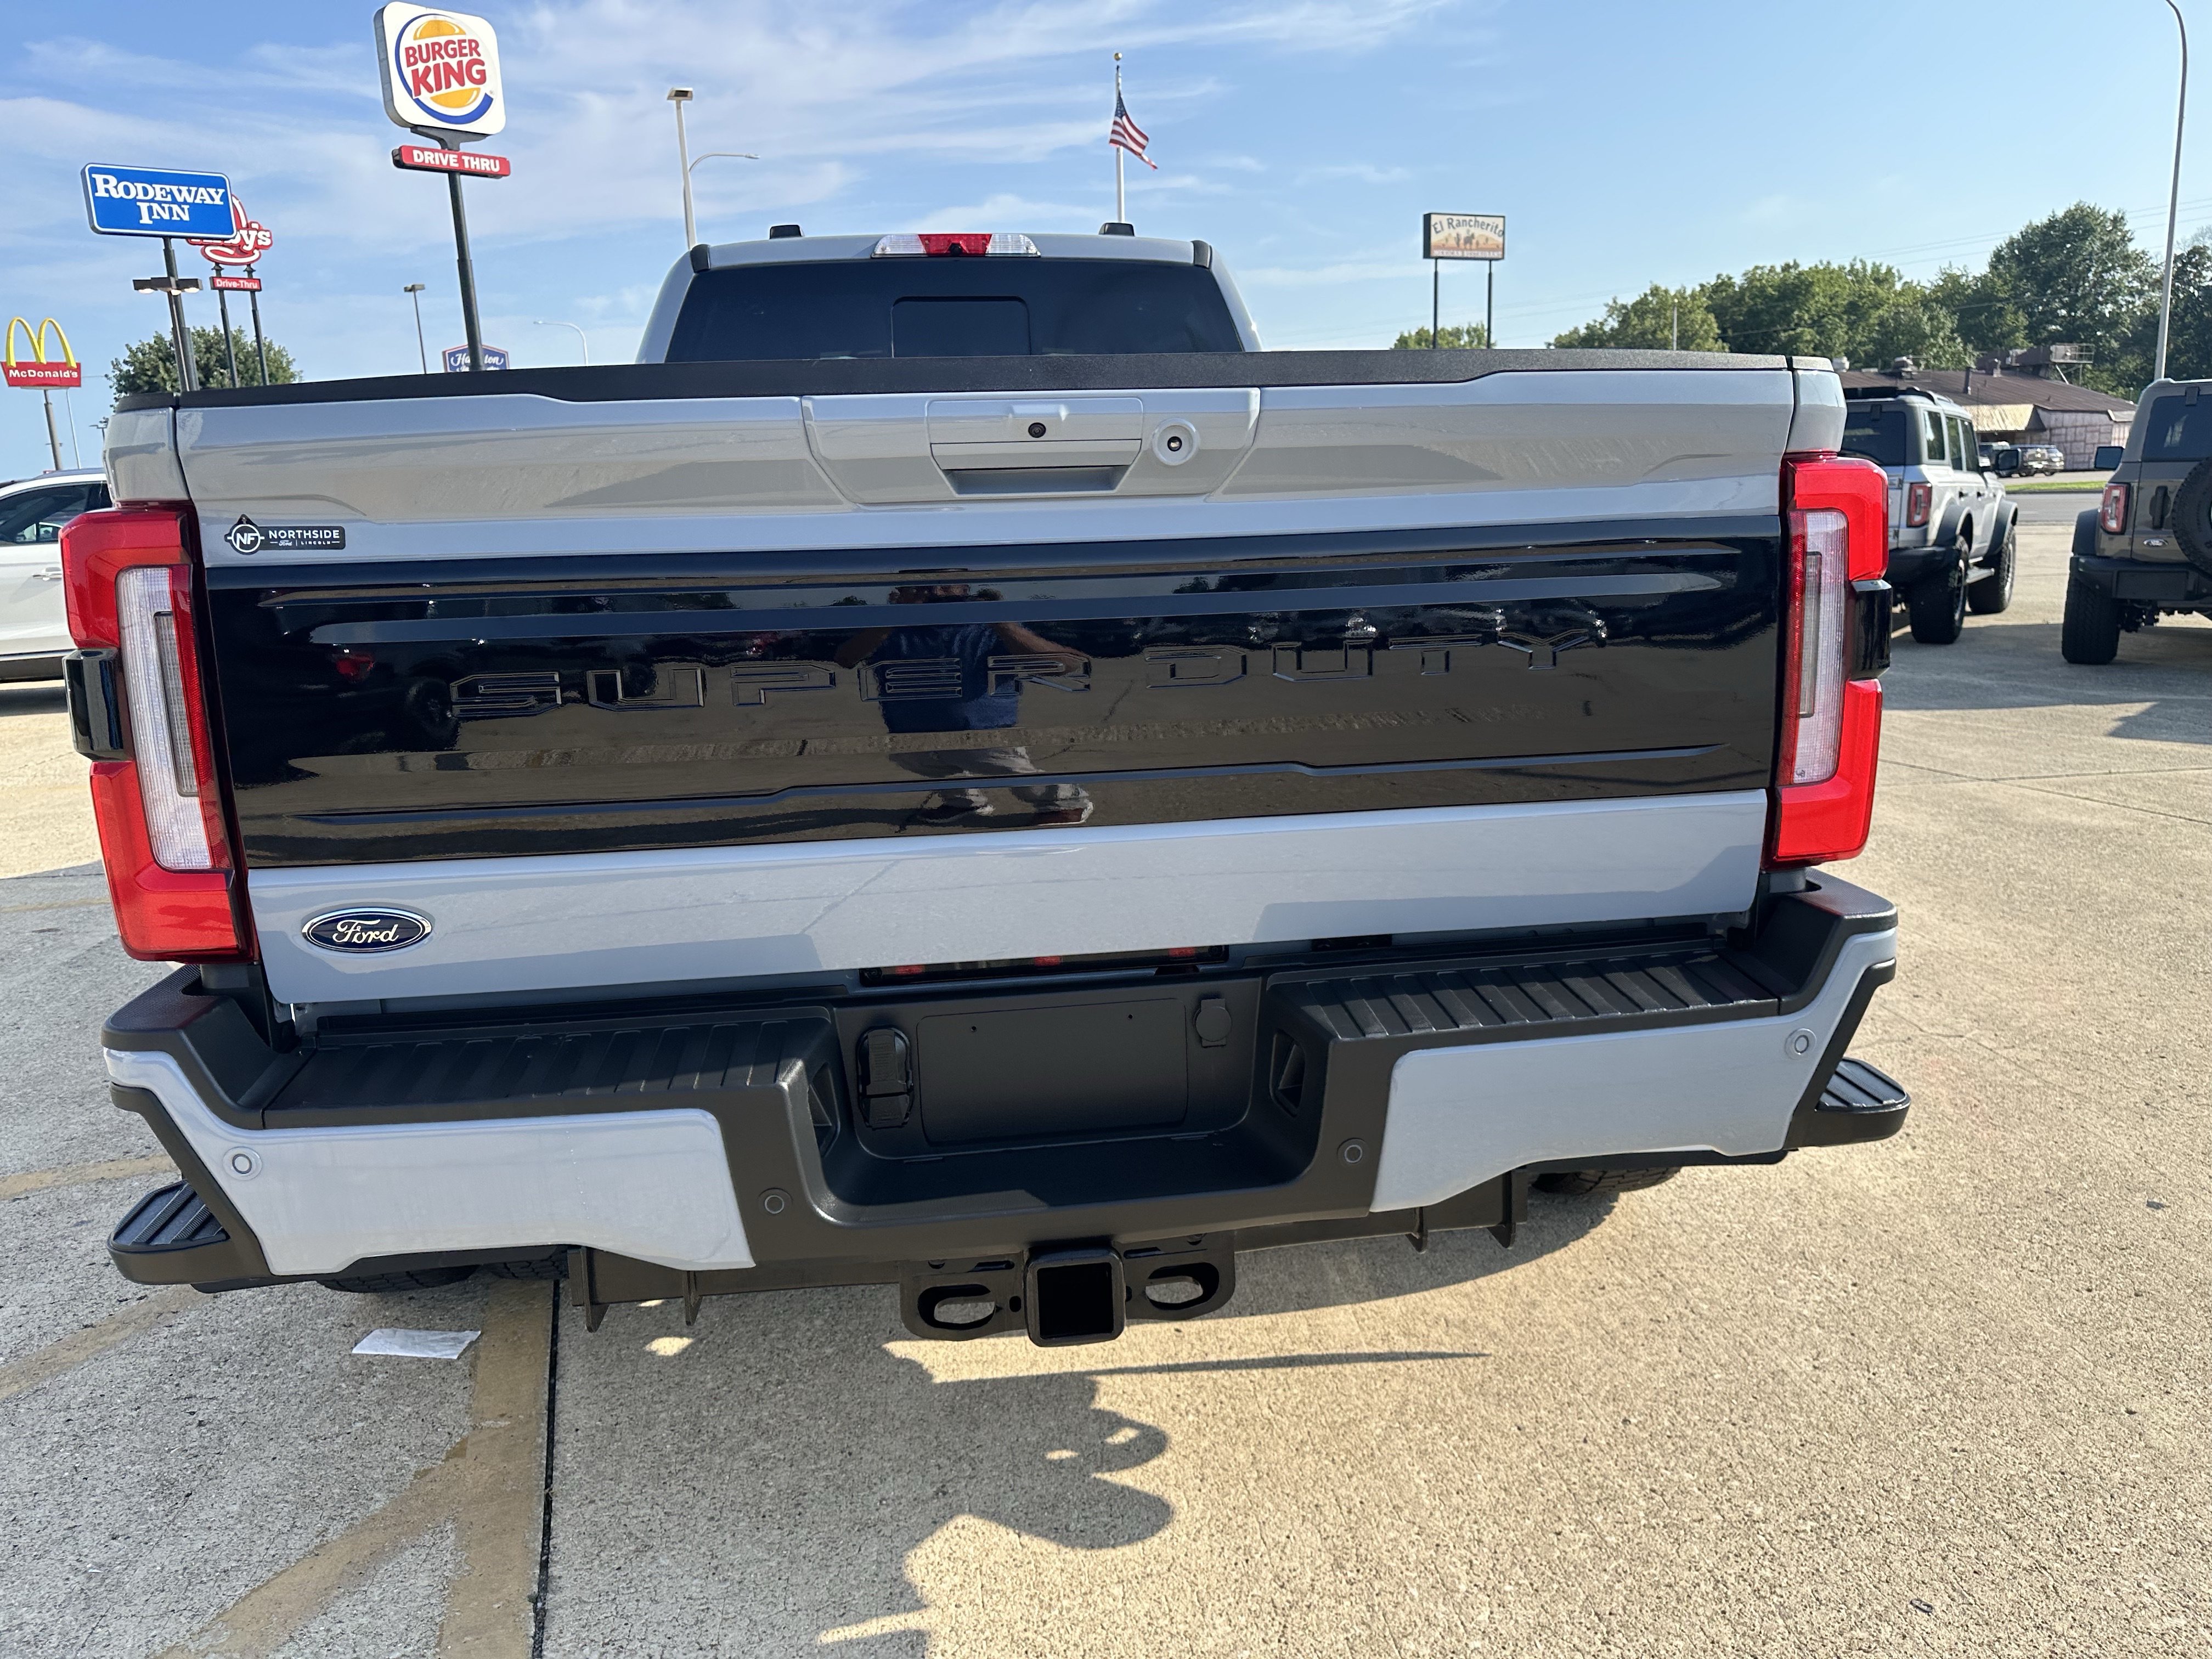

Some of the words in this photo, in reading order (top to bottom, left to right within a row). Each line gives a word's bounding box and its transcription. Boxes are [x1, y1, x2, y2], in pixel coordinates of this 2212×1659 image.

[405, 39, 481, 67] BURGER
[411, 58, 487, 97] KING
[412, 149, 459, 167] DRIVE
[461, 155, 500, 172] THRU
[92, 173, 225, 205] RODEWAY
[137, 202, 190, 224] INN
[1432, 221, 1444, 234] El
[1447, 217, 1504, 237] Rancherito
[216, 279, 258, 289] Drive-Thru
[9, 369, 78, 378] McDonald's
[236, 533, 258, 549] NF
[268, 529, 340, 539] NORTHSIDE
[449, 652, 1091, 717] SUPER
[1143, 629, 1589, 689] DUTY
[332, 919, 399, 943] Ford
